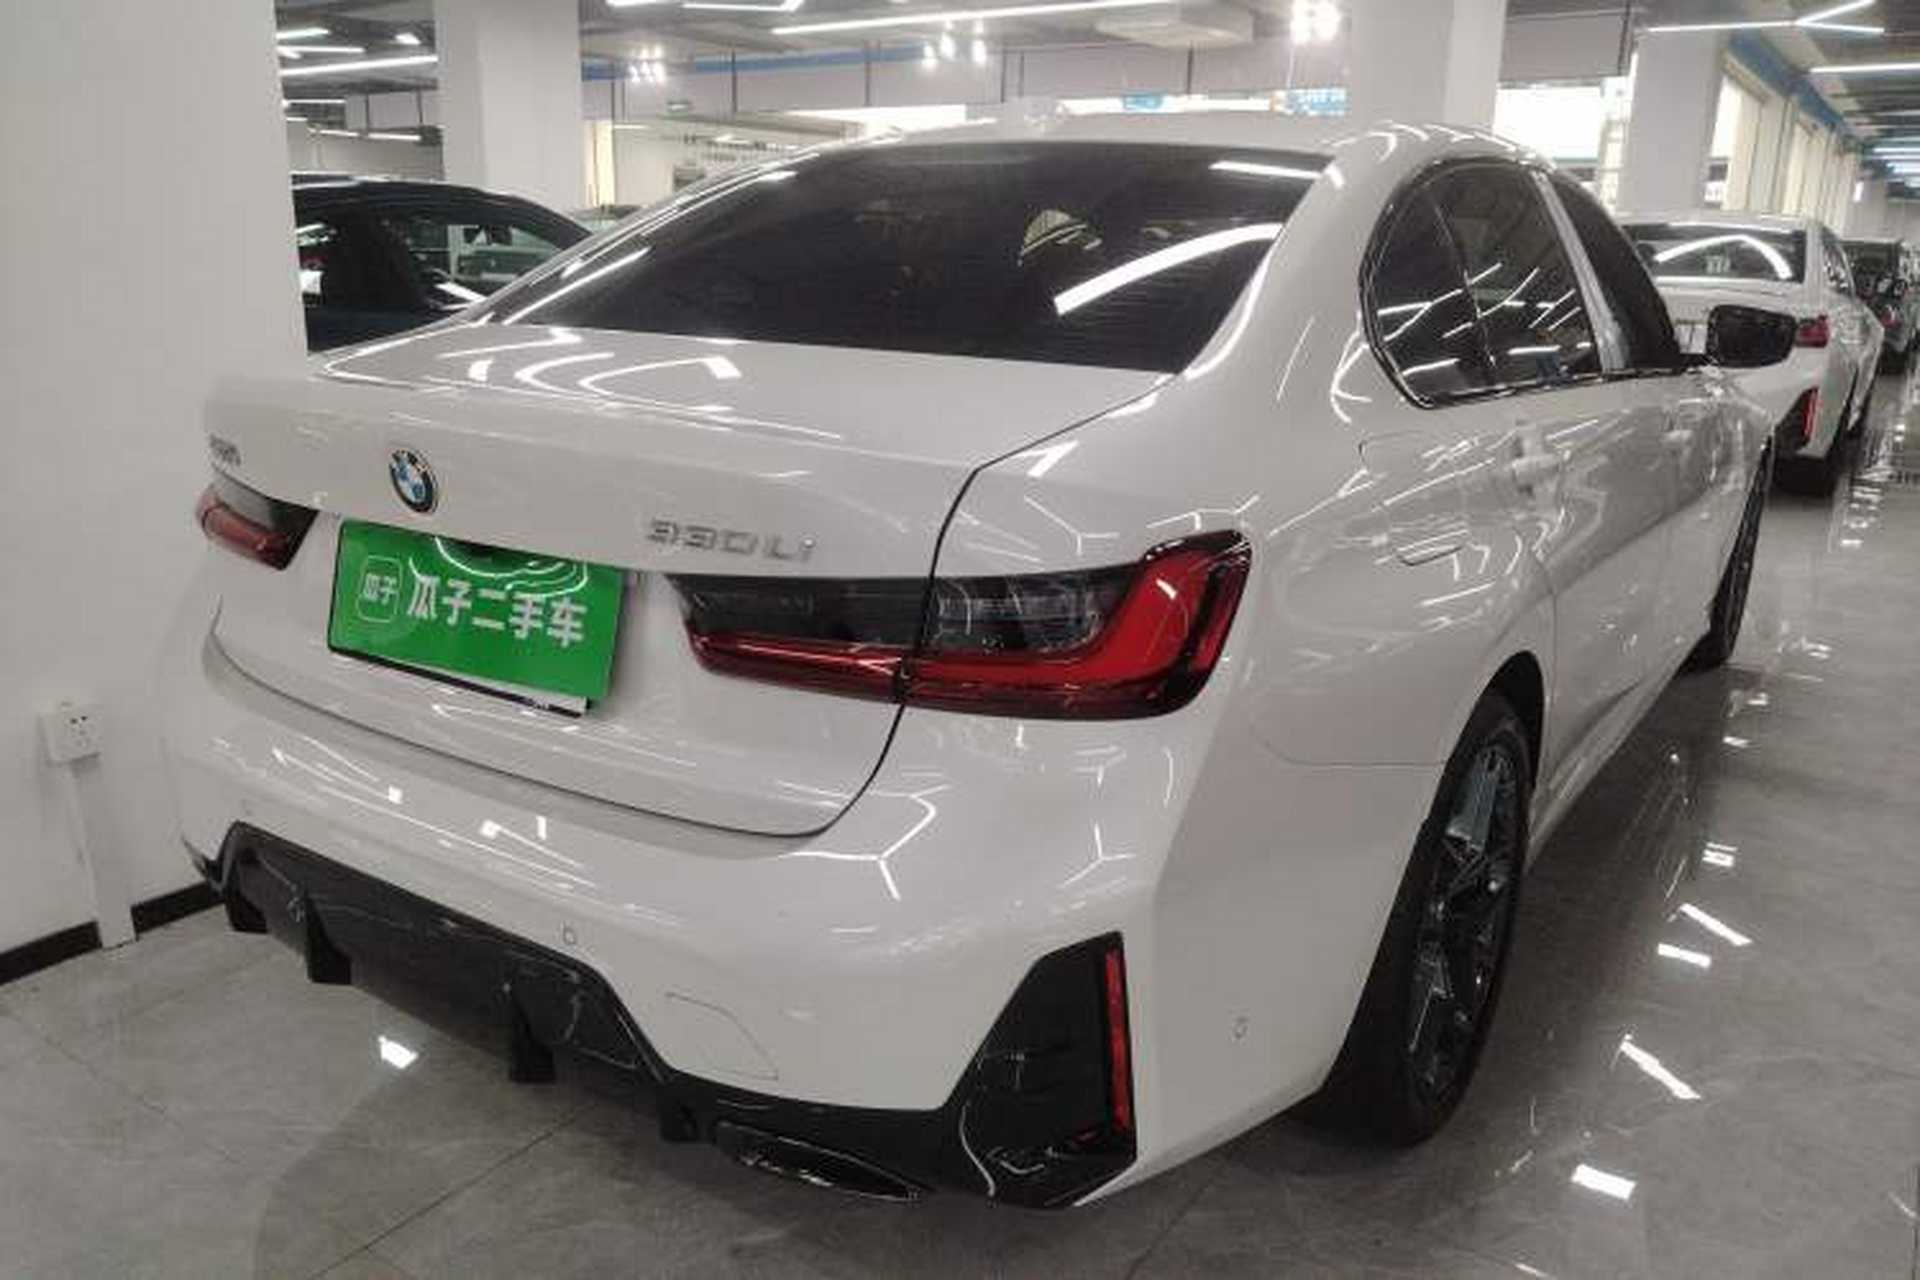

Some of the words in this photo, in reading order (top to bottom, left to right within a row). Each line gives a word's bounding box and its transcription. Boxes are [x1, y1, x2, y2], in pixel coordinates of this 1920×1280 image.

[406, 574, 588, 648] 瓜子二手车
